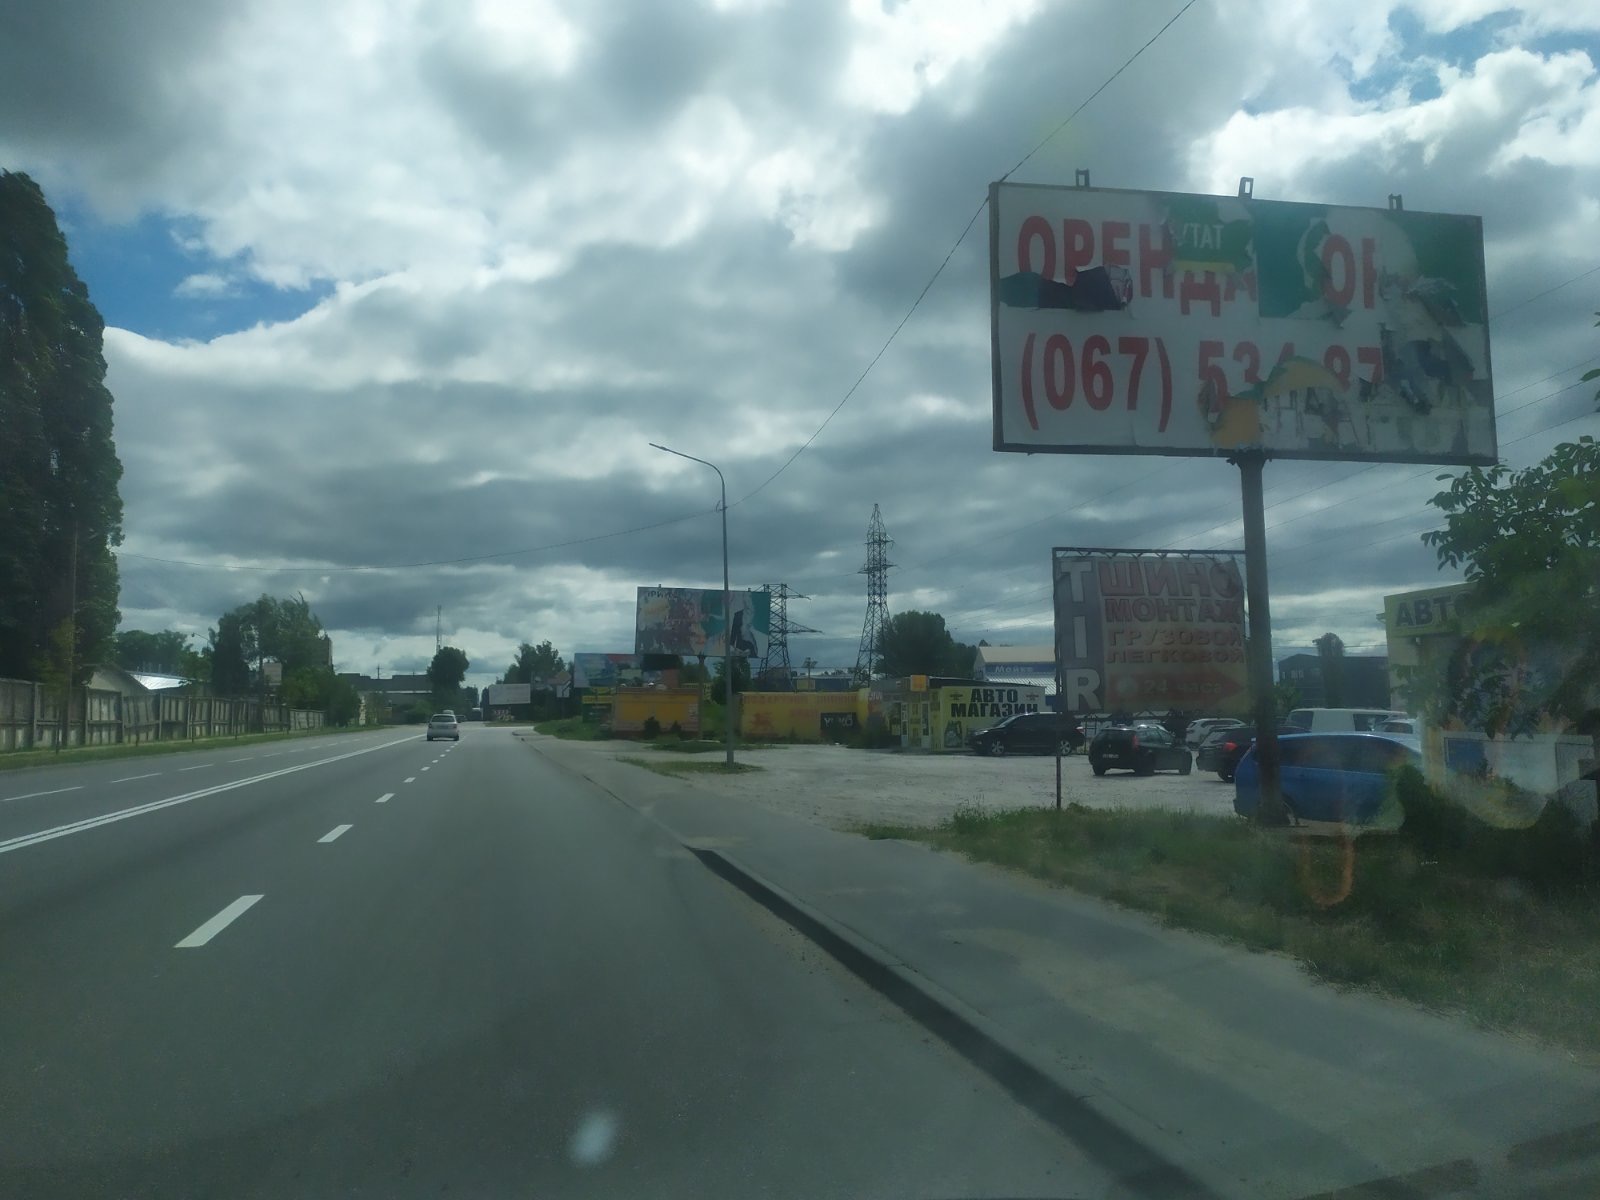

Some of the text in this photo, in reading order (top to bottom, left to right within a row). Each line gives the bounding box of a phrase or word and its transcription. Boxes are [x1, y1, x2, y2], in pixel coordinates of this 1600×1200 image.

[1021, 333, 1173, 434] (067)
[1198, 341, 1296, 412] 53
[1105, 598, 1242, 624] МОНТАЖ
[1059, 561, 1101, 712] TIR
[971, 688, 1019, 703] АВТО
[950, 703, 1039, 718] МАГАЗИН
